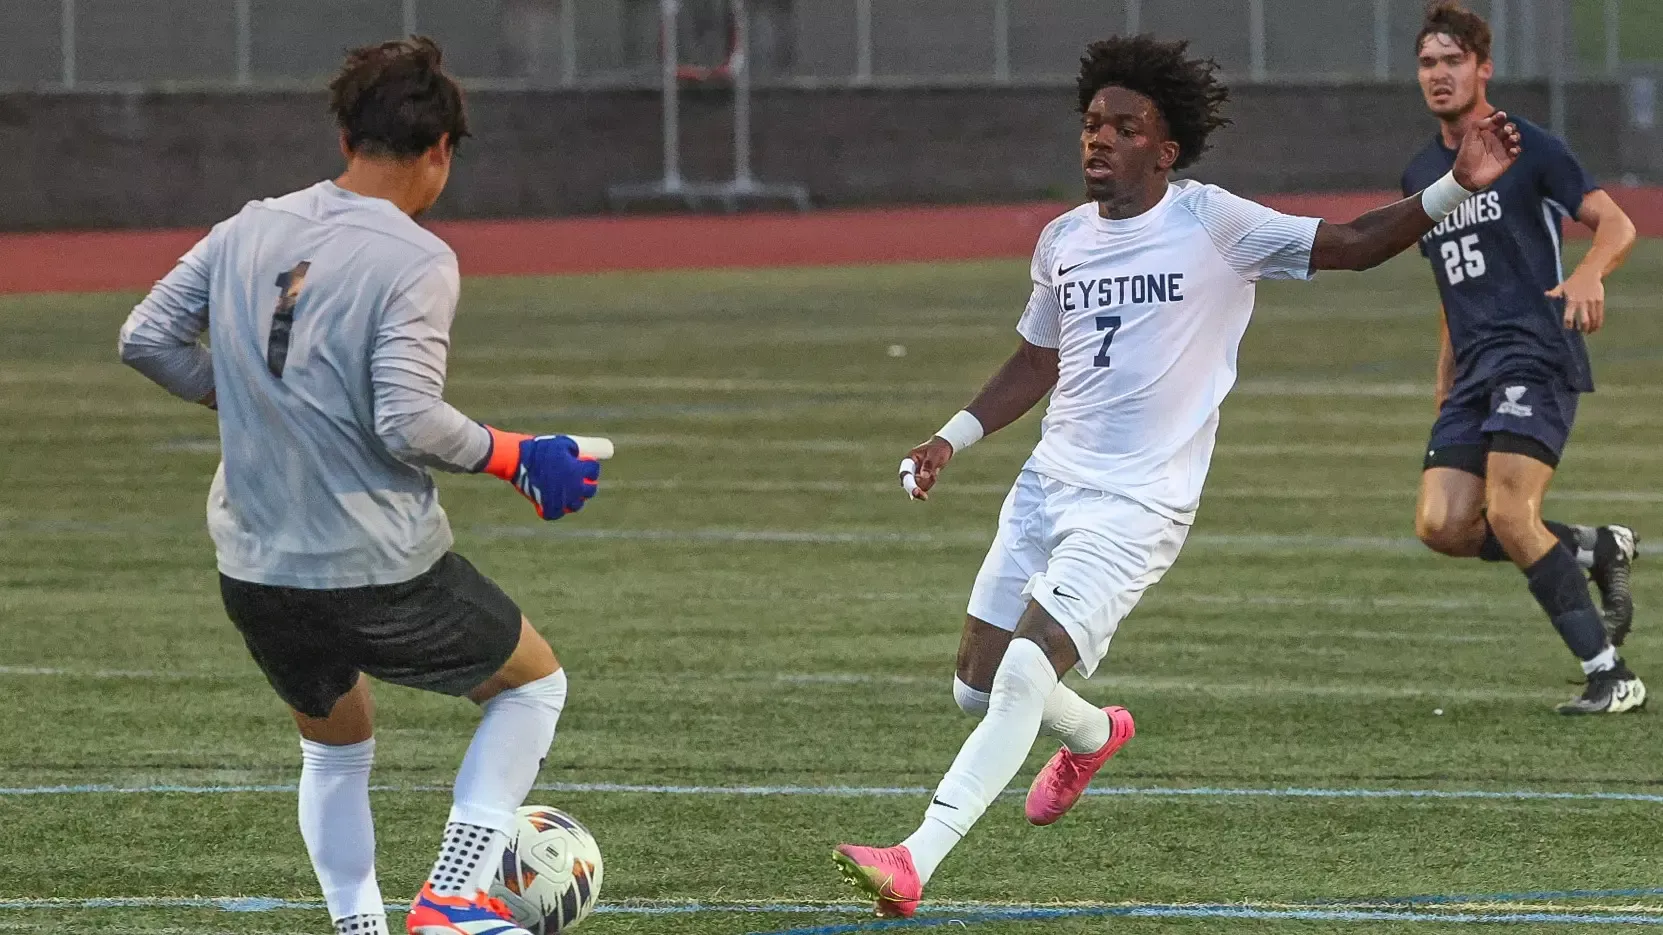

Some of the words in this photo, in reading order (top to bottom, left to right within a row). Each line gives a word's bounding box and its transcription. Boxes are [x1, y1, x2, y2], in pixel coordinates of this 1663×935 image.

[1440, 233, 1486, 286] 25
[267, 260, 311, 379] 1
[1093, 316, 1121, 367] 7
